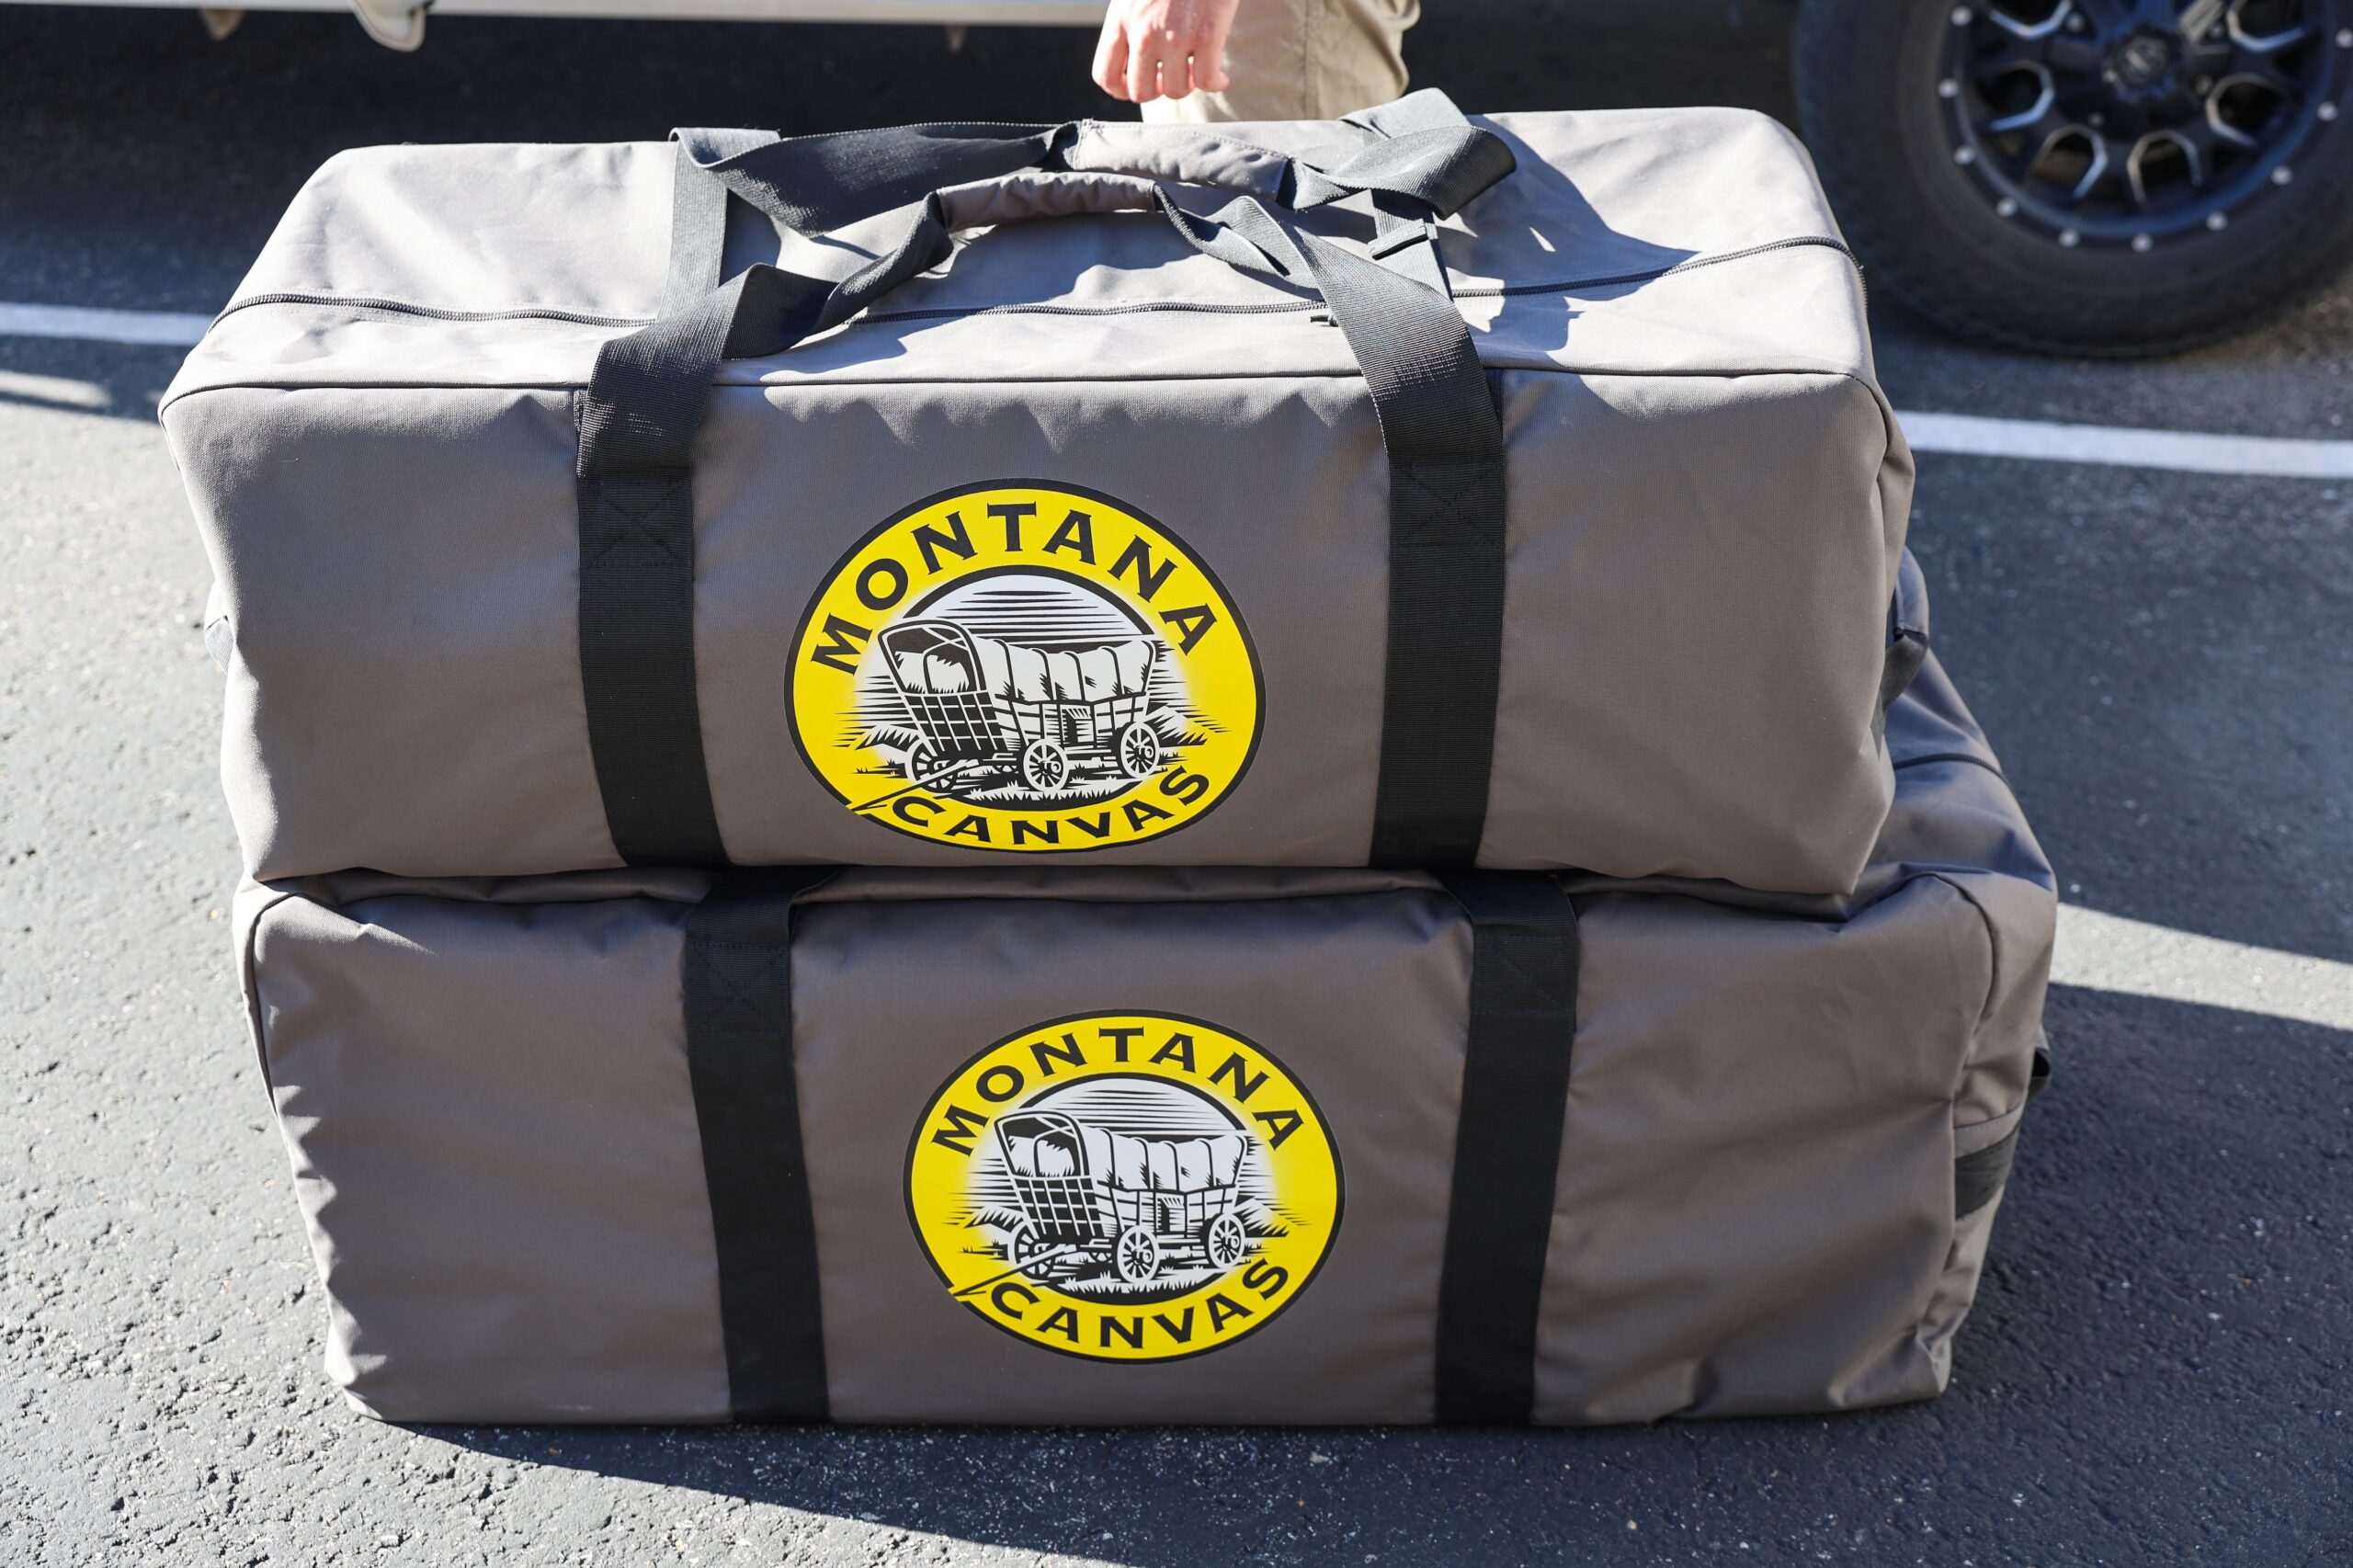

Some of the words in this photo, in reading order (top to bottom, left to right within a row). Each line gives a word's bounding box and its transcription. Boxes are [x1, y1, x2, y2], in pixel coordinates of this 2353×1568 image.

[811, 501, 1218, 676] MONTANA
[892, 765, 1210, 845] CANVAS
[931, 1027, 1304, 1156] MONTANA
[992, 1257, 1288, 1348] CANVAS
